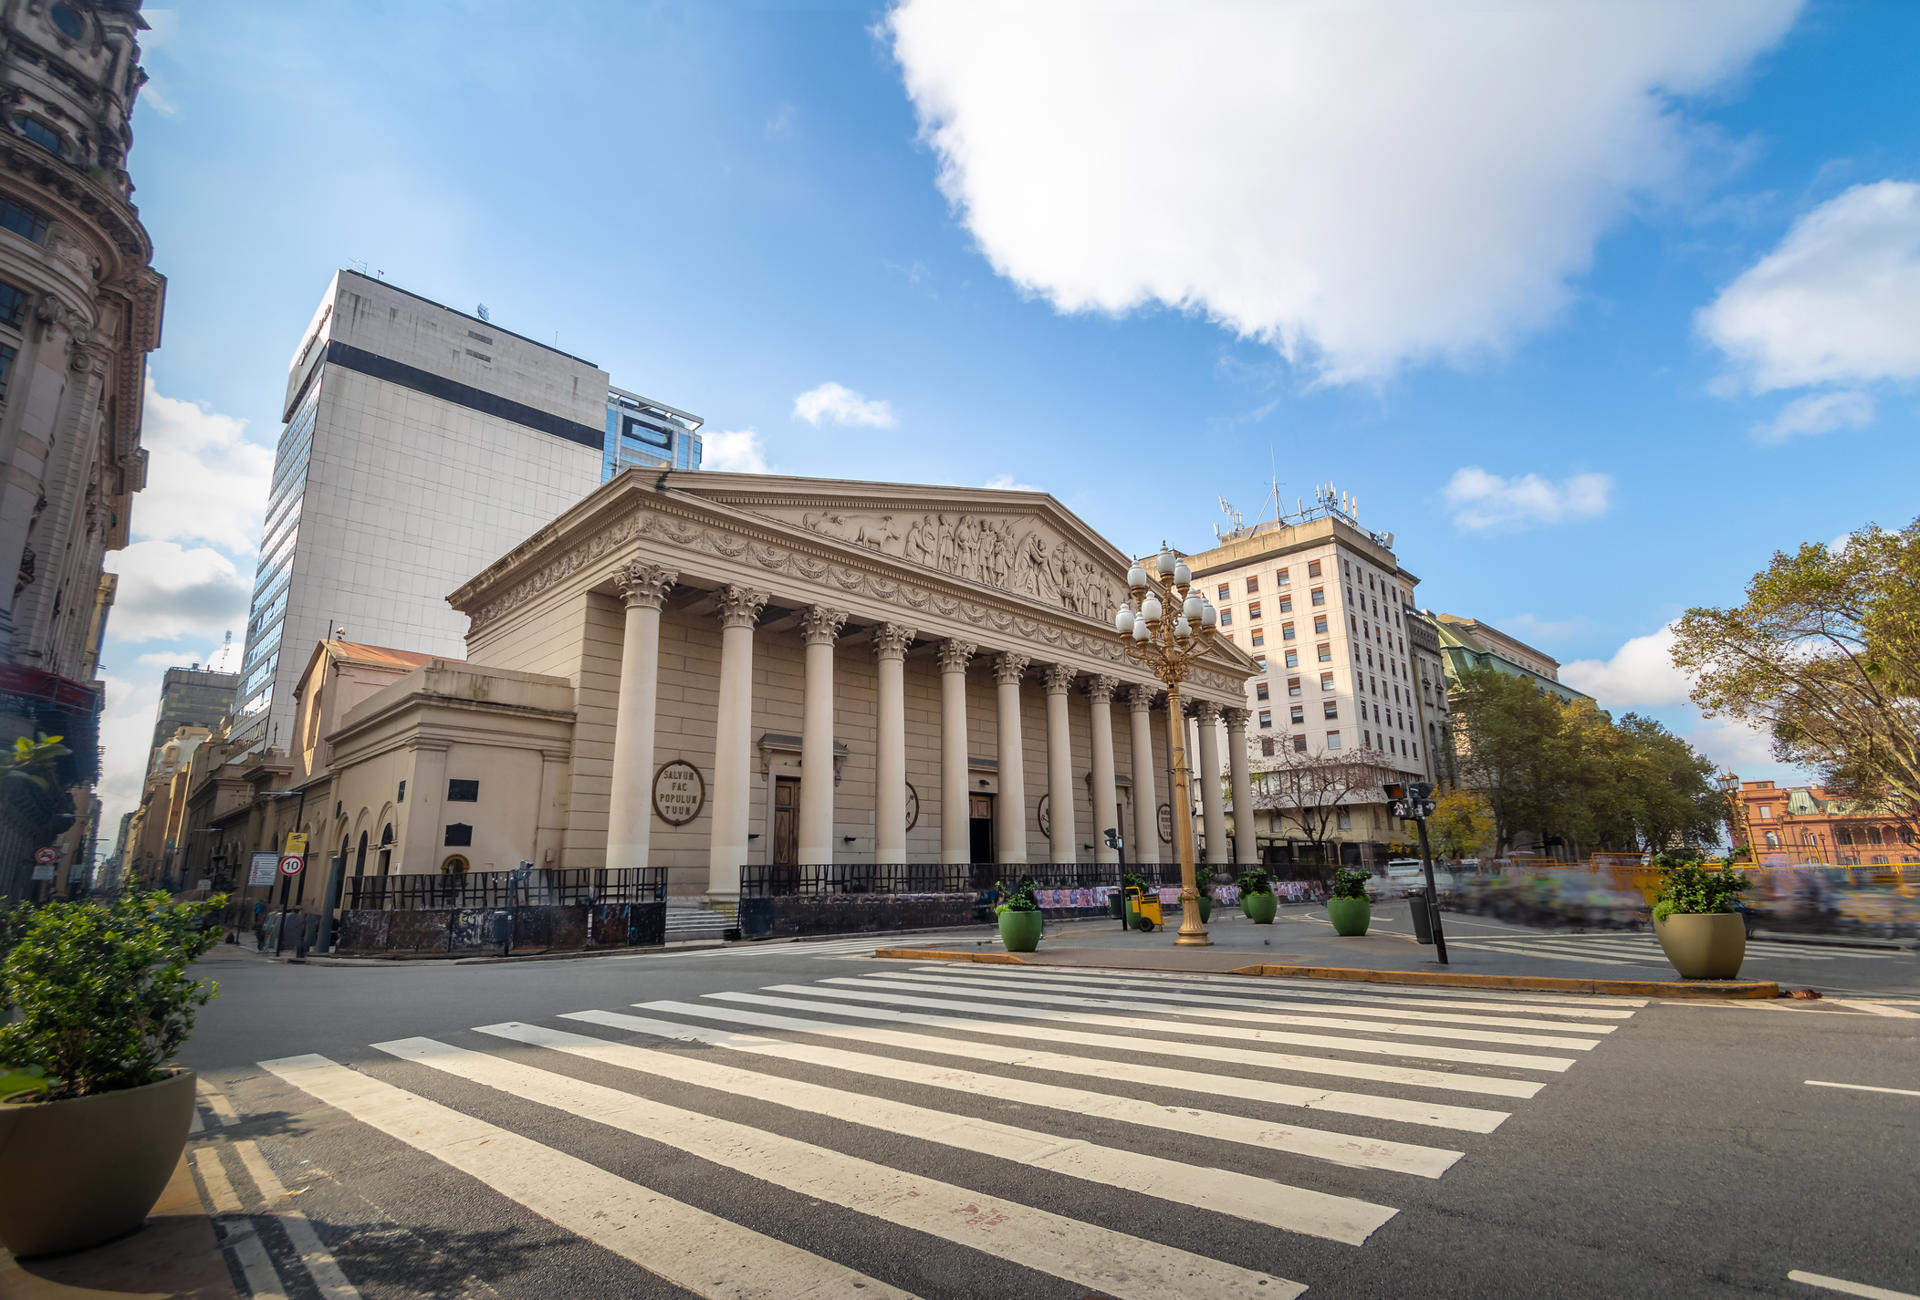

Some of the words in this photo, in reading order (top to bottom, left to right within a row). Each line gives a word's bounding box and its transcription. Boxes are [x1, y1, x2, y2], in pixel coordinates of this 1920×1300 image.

[663, 770, 694, 780] SALVUM
[672, 782, 687, 791] FAC
[660, 793, 697, 804] POPULUM
[285, 861, 299, 870] 10
